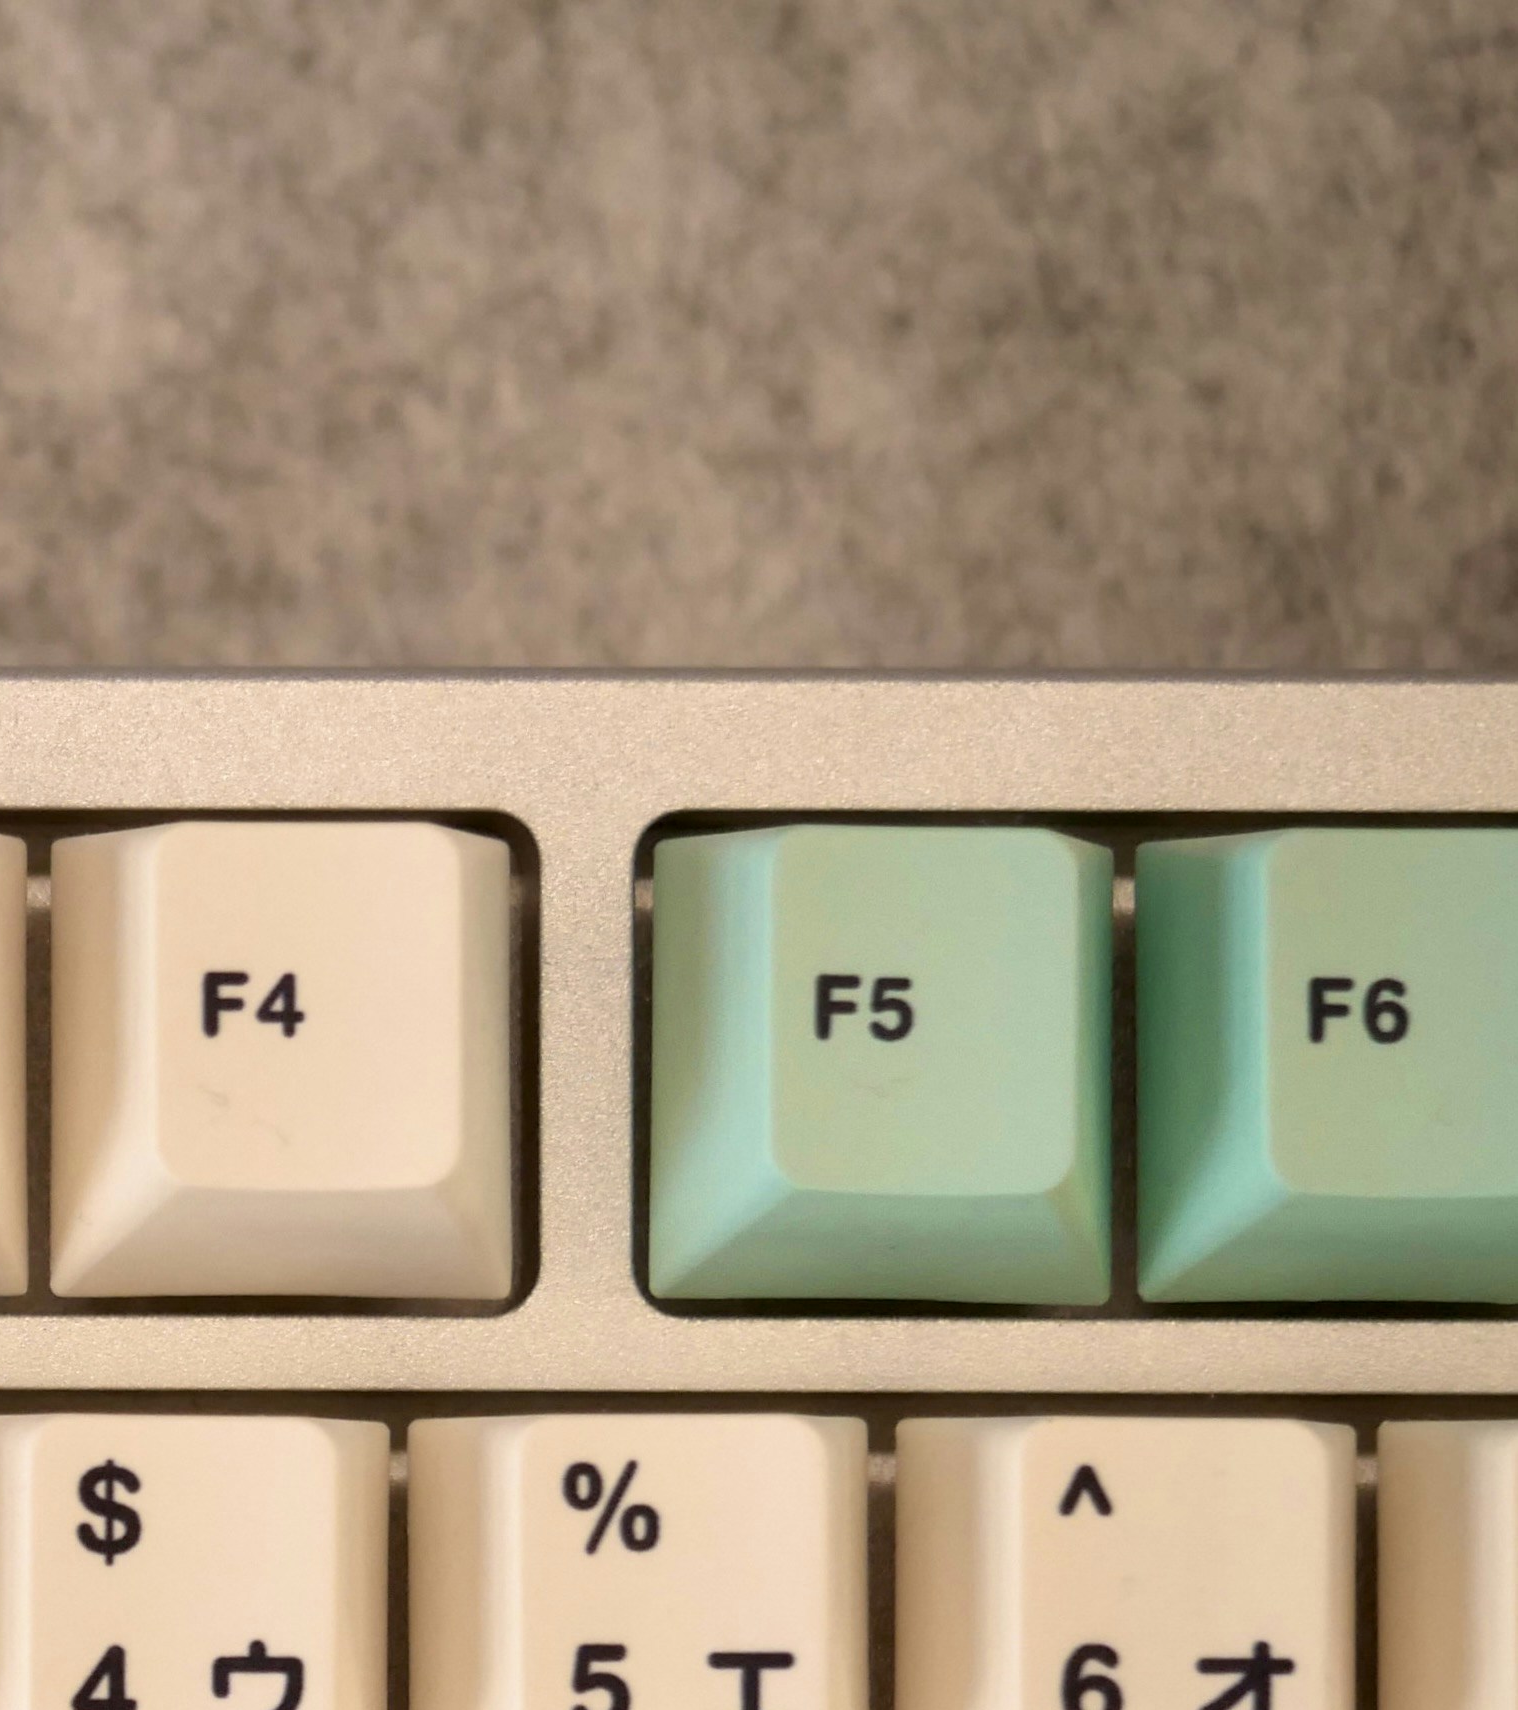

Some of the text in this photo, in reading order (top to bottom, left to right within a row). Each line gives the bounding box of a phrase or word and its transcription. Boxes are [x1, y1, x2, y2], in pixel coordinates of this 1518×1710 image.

[202, 970, 306, 1039] F4
[814, 972, 915, 1043] F5
[1307, 975, 1411, 1046] F6
[76, 1458, 143, 1567] $
[562, 1459, 661, 1556] %
[1059, 1464, 1114, 1517] ^
